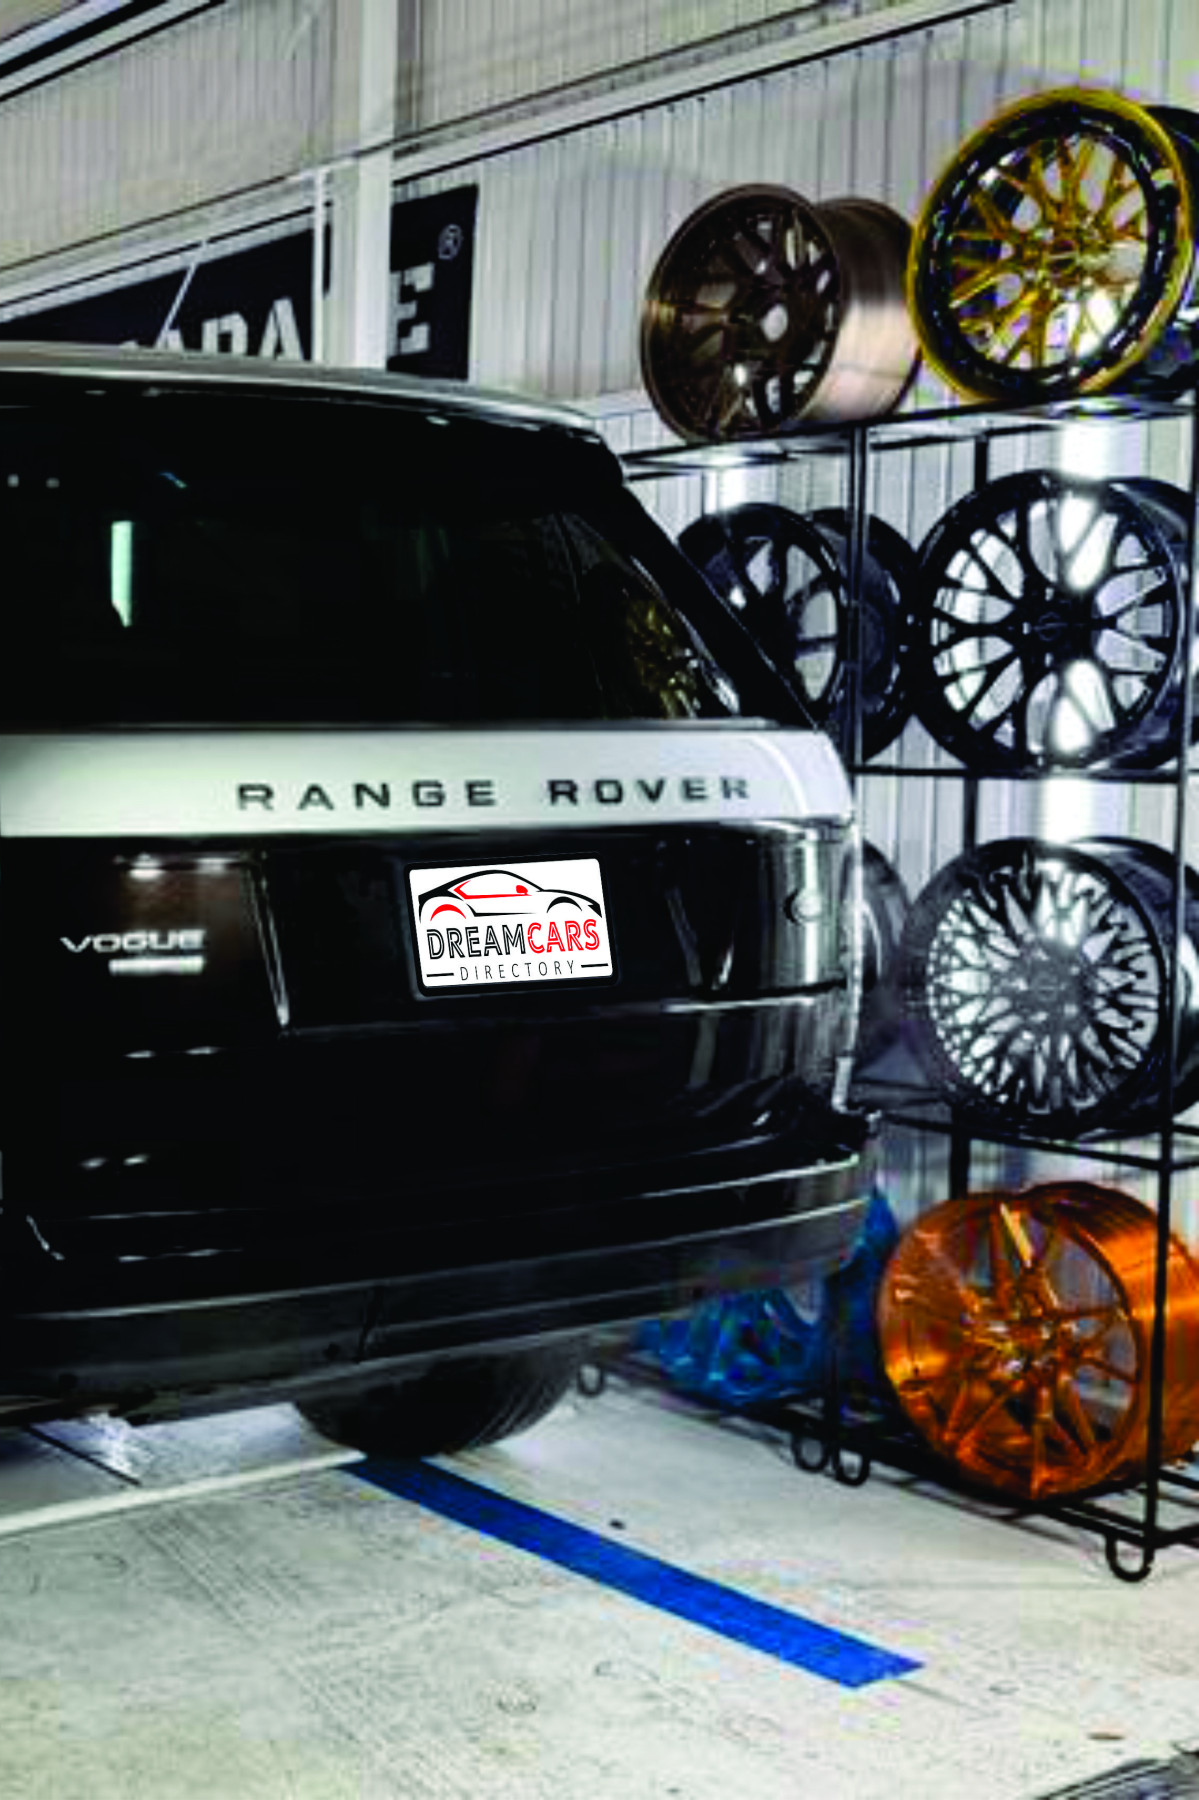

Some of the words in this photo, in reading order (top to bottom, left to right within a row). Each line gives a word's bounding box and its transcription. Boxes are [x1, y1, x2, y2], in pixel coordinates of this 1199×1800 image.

[236, 780, 496, 811] RANGE
[546, 777, 749, 807] ROVER
[59, 928, 206, 954] VOGUE
